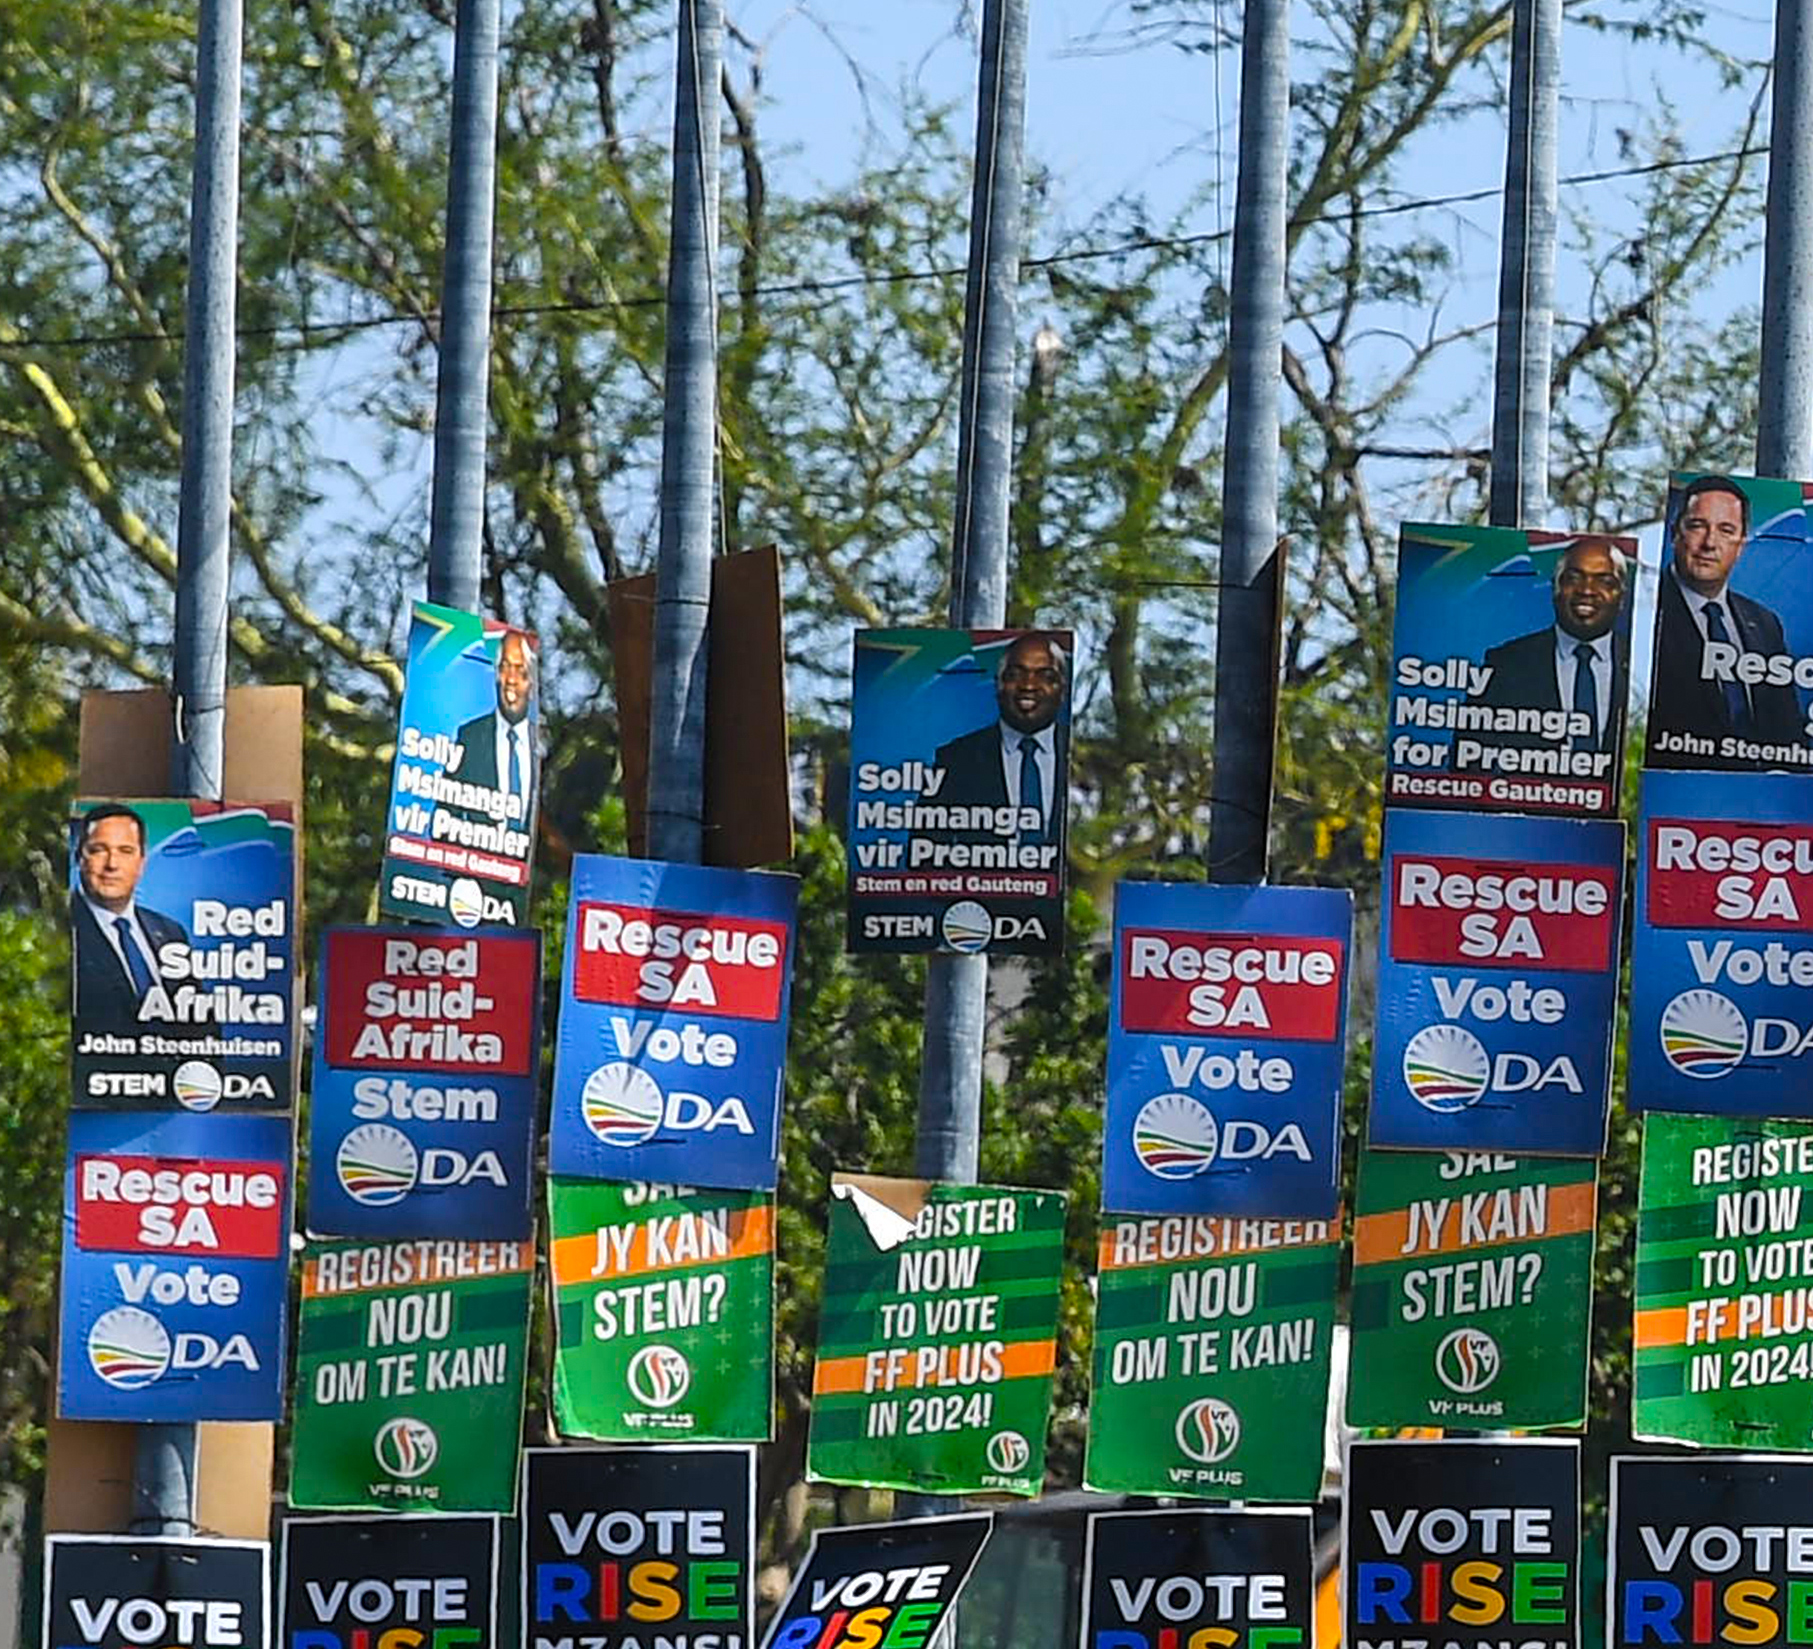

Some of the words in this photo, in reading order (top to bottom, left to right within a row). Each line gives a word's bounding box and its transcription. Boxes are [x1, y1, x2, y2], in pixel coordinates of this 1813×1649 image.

[401, 728, 465, 772] Solly
[398, 764, 522, 819] Msimanga
[858, 761, 946, 795] Solly
[394, 805, 430, 839] vir
[432, 815, 530, 859] Premier
[856, 801, 1042, 835] Msimanga
[856, 841, 902, 870] vir
[909, 840, 1058, 869] Premier
[391, 875, 446, 908] STEM
[481, 899, 516, 926] DA
[855, 876, 901, 892] Stem
[905, 879, 926, 892] en
[929, 875, 961, 892] red
[965, 875, 1048, 895] Gauteng
[192, 900, 285, 936] Red
[864, 914, 934, 939] STEM
[991, 915, 1046, 940] DA
[159, 944, 285, 980] Suid-
[138, 986, 285, 1024] Afrika
[78, 1034, 135, 1055] John
[139, 1034, 281, 1058] Steenhuisen
[88, 1072, 166, 1098] STEM
[221, 1074, 275, 1100] DA
[81, 1160, 279, 1208] Rescue
[138, 1206, 218, 1249] SA
[1715, 1188, 1801, 1239] NOW
[112, 1262, 241, 1306] Vote
[898, 1246, 981, 1295] NOW
[1699, 1246, 1740, 1289] TO
[366, 1292, 452, 1348] NOU
[880, 1304, 918, 1340] TO
[924, 1296, 998, 1335] VOTE
[1686, 1299, 1730, 1346] FF
[170, 1331, 260, 1371] DA
[865, 1355, 906, 1394] FF
[916, 1342, 1005, 1389] PLUS
[315, 1360, 366, 1405] OM
[378, 1356, 418, 1398] TE
[425, 1344, 505, 1392] KAN!
[1691, 1355, 1722, 1392] IN
[868, 1401, 899, 1438] IN
[906, 1394, 991, 1432] 2024!
[1195, 1470, 1244, 1485] PLUS
[811, 1565, 950, 1611] VOTE
[70, 1600, 242, 1645] VOTE
